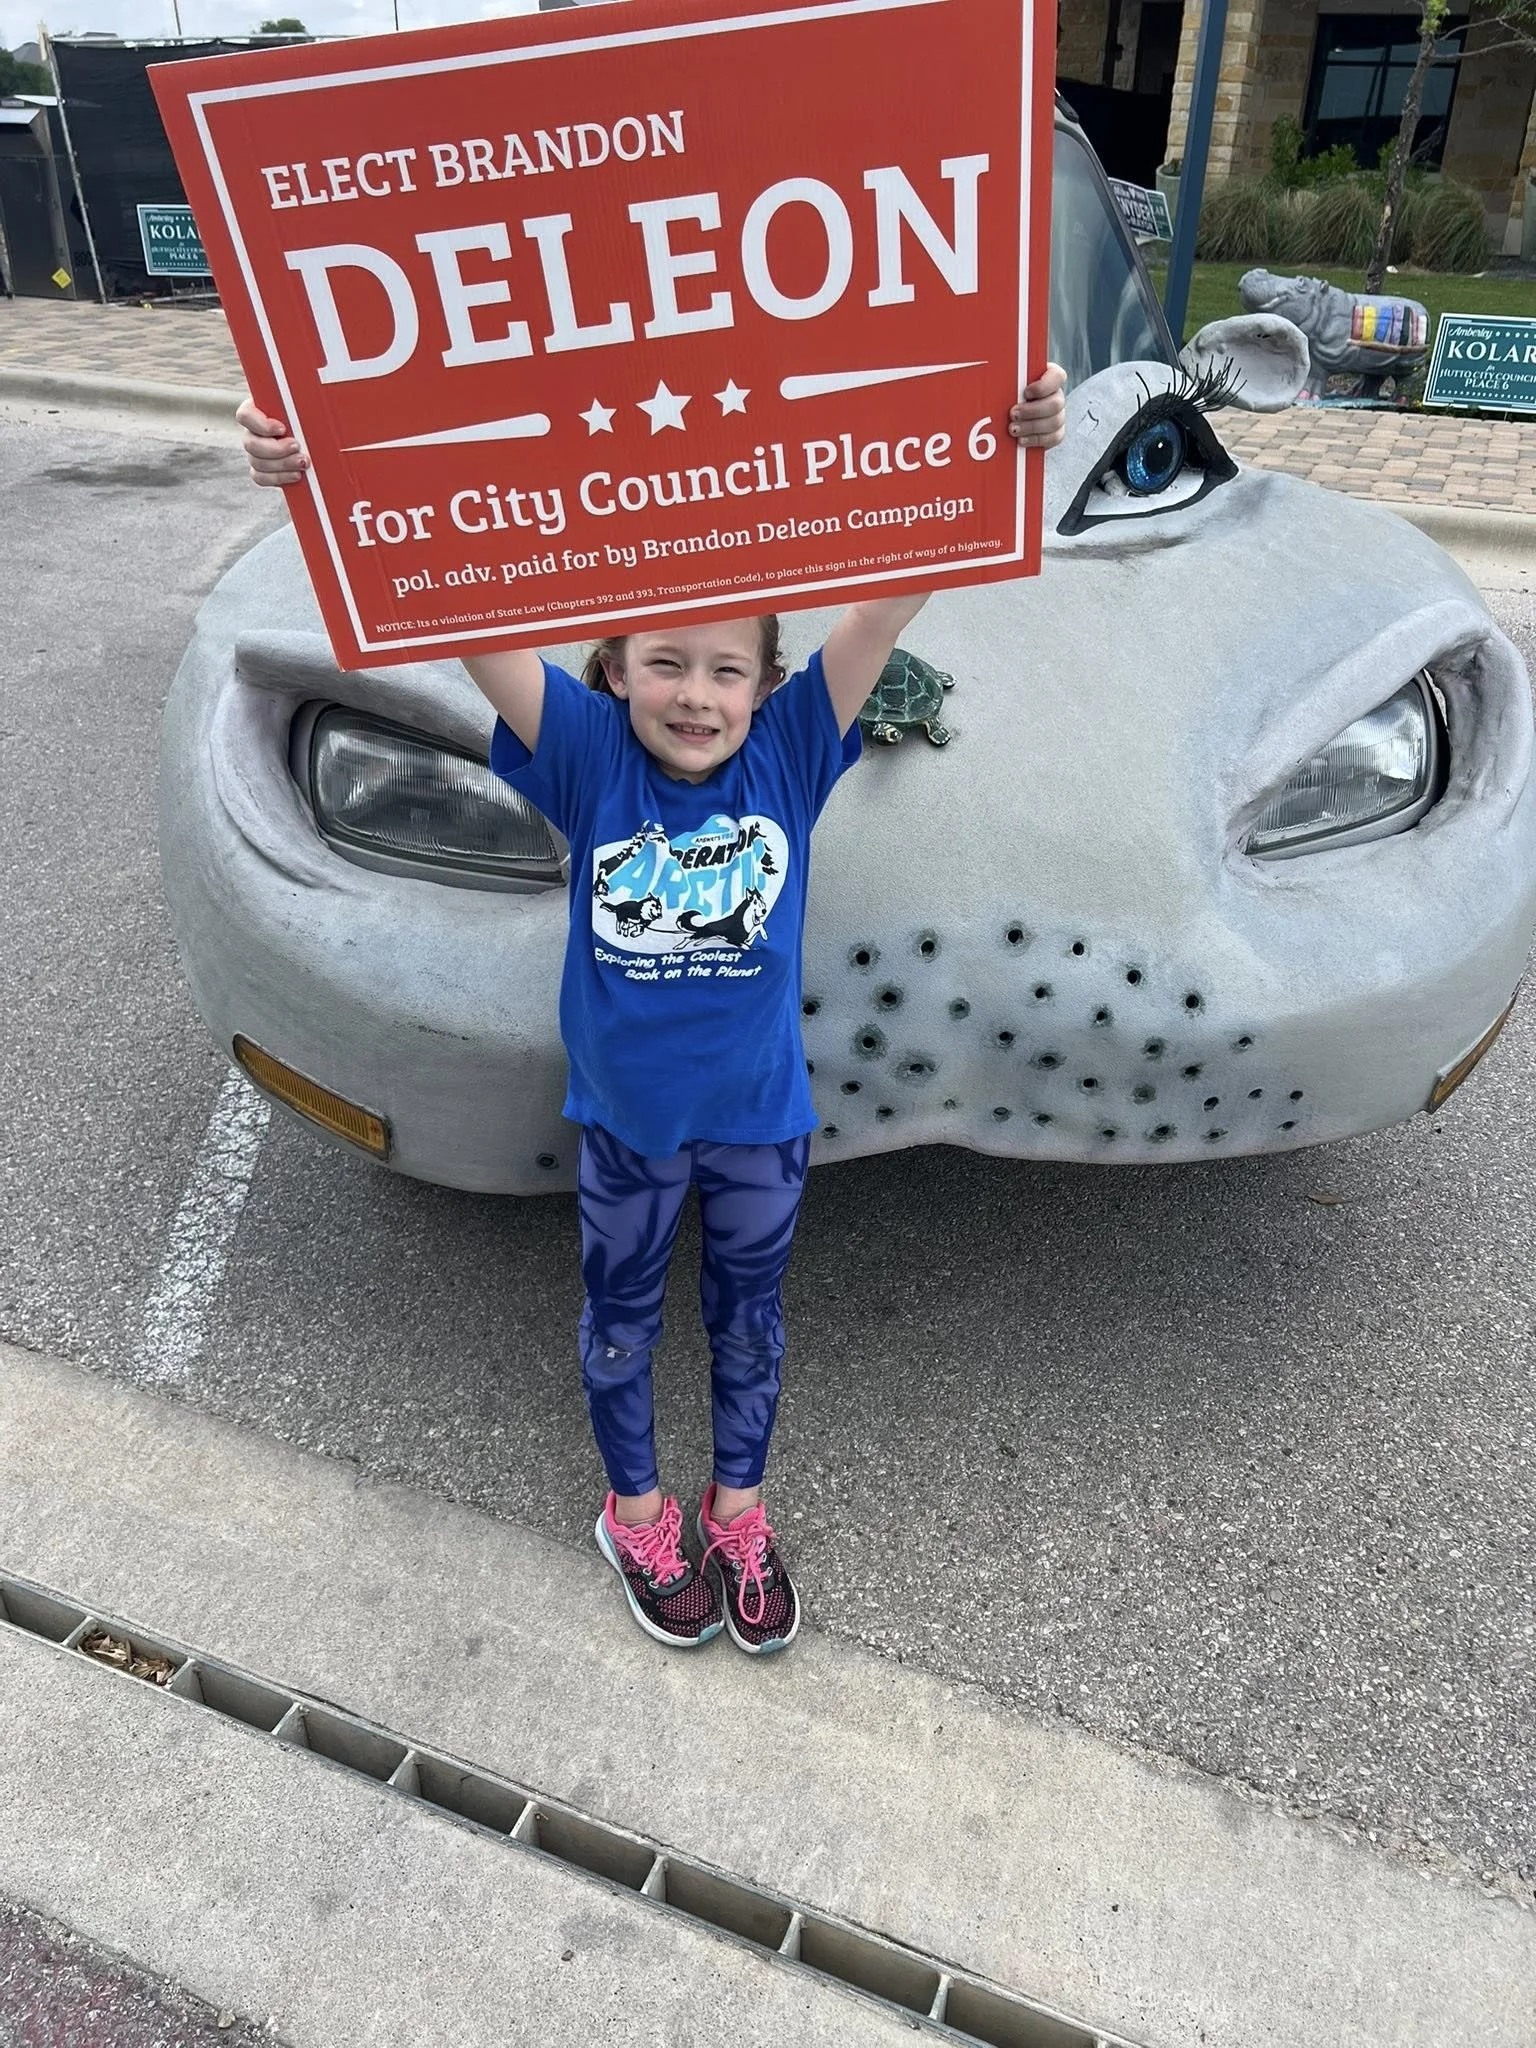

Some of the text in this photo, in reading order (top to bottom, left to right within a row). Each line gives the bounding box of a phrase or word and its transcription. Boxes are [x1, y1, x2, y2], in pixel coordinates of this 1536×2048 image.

[260, 109, 685, 210] ELECT BRANDON
[1116, 195, 1154, 223] NYDER
[150, 224, 201, 239] KOLA
[283, 153, 990, 385] DELEON
[1448, 326, 1494, 340] Amberley
[1447, 340, 1536, 364] KOLAR
[1439, 367, 1472, 378] HUTTO
[1473, 370, 1496, 380] CITY
[1464, 378, 1510, 391] PLACE 6
[348, 416, 997, 548] for City Council Place 6
[391, 496, 975, 599] pol. adv. paid for by Brandon Deleon Campaign
[375, 620, 415, 633] NOTICE:
[416, 619, 431, 628] Its
[439, 613, 485, 625] violation
[485, 609, 496, 619] of
[496, 608, 523, 618] State
[523, 605, 545, 614] Law
[546, 598, 596, 613] (Chapters
[596, 594, 614, 604] 392
[615, 590, 635, 602] and
[635, 588, 657, 599] 393,
[656, 578, 732, 595] Transportation
[733, 572, 764, 585] Code),
[765, 572, 776, 580] to
[776, 568, 803, 580] place
[804, 563, 824, 574] this
[824, 561, 846, 572] sign
[847, 559, 858, 568] in
[859, 556, 875, 566] the
[876, 552, 902, 565] right
[903, 549, 913, 560] of
[914, 548, 936, 558] way
[937, 544, 948, 555] of
[949, 545, 956, 553] a
[957, 539, 1003, 553] highway.
[594, 947, 742, 969] Exploring the Coolest
[625, 965, 762, 981] Book on the Planet
